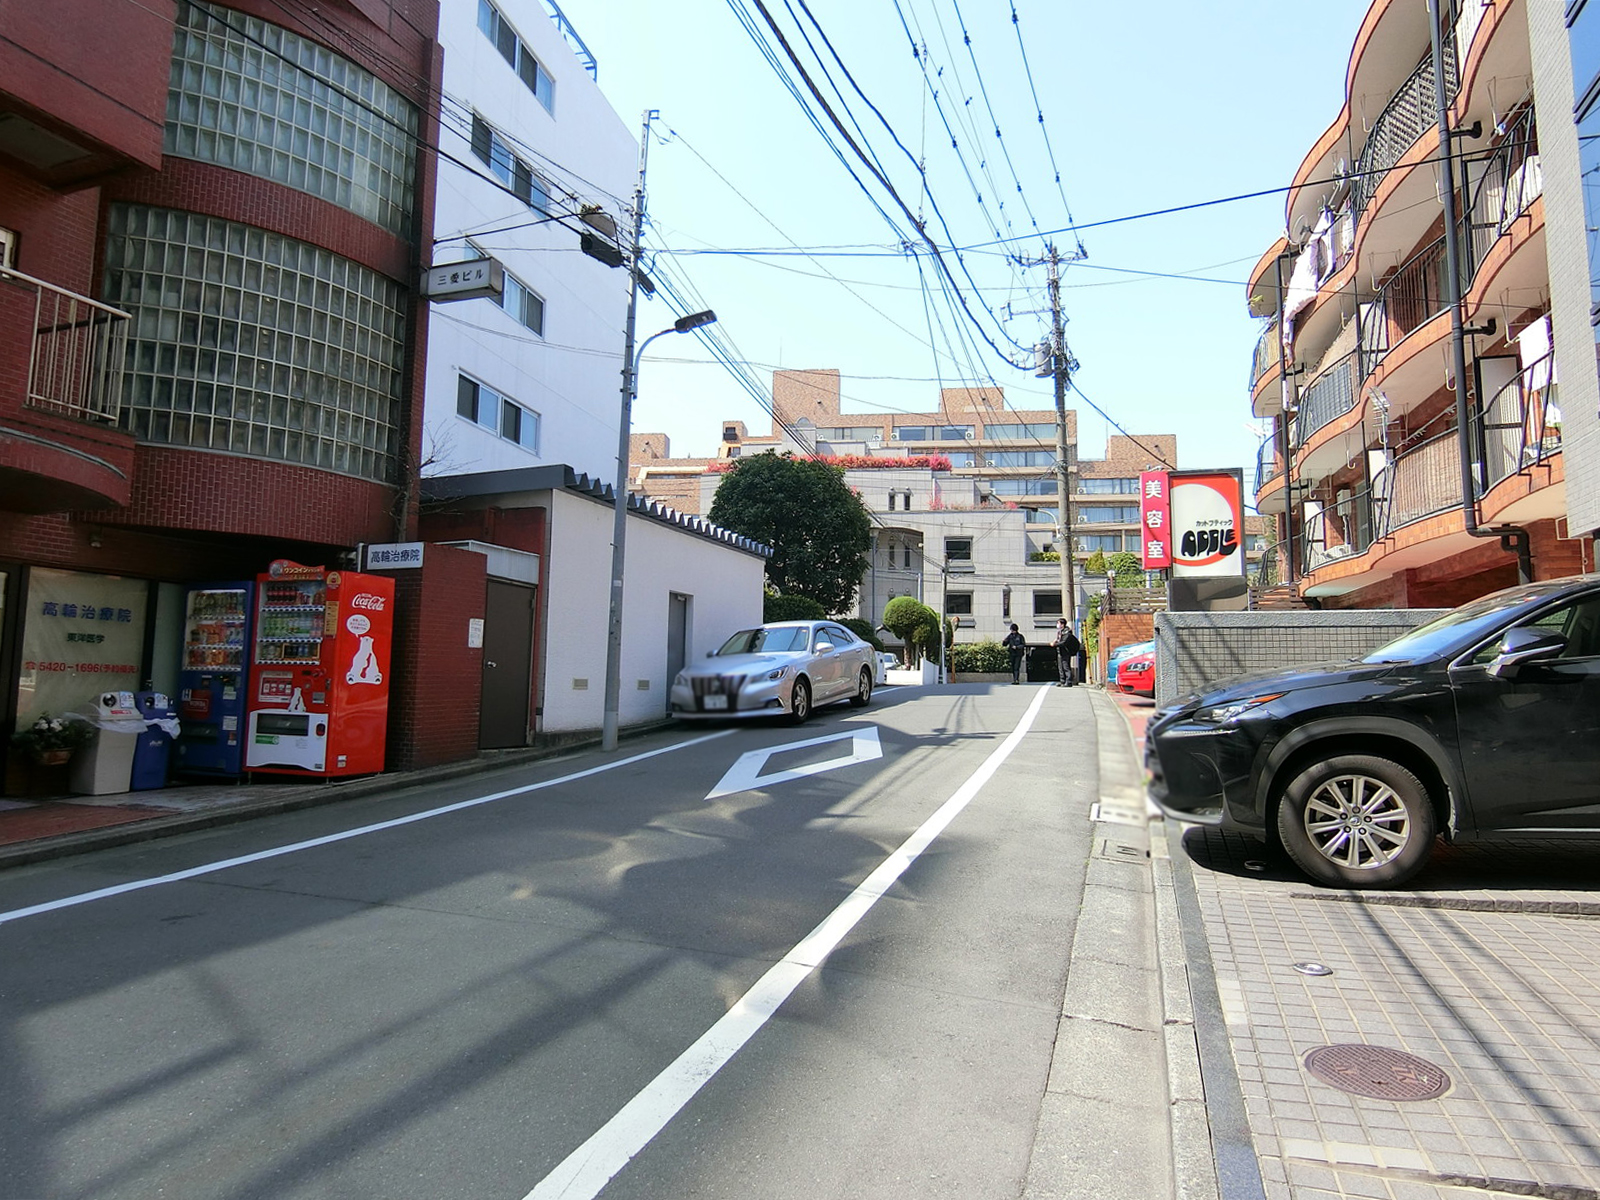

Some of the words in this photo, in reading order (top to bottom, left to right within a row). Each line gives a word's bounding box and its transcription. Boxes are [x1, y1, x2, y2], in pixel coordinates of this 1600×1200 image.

[437, 268, 485, 286] 三愛ビル
[1145, 480, 1164, 559] 美容室
[1181, 528, 1238, 557] APPLE
[370, 548, 420, 563] 高輪治療院
[351, 593, 386, 611] Coca-Cola
[42, 601, 132, 623] 高輪治療院
[66, 632, 106, 644] 東洋医学
